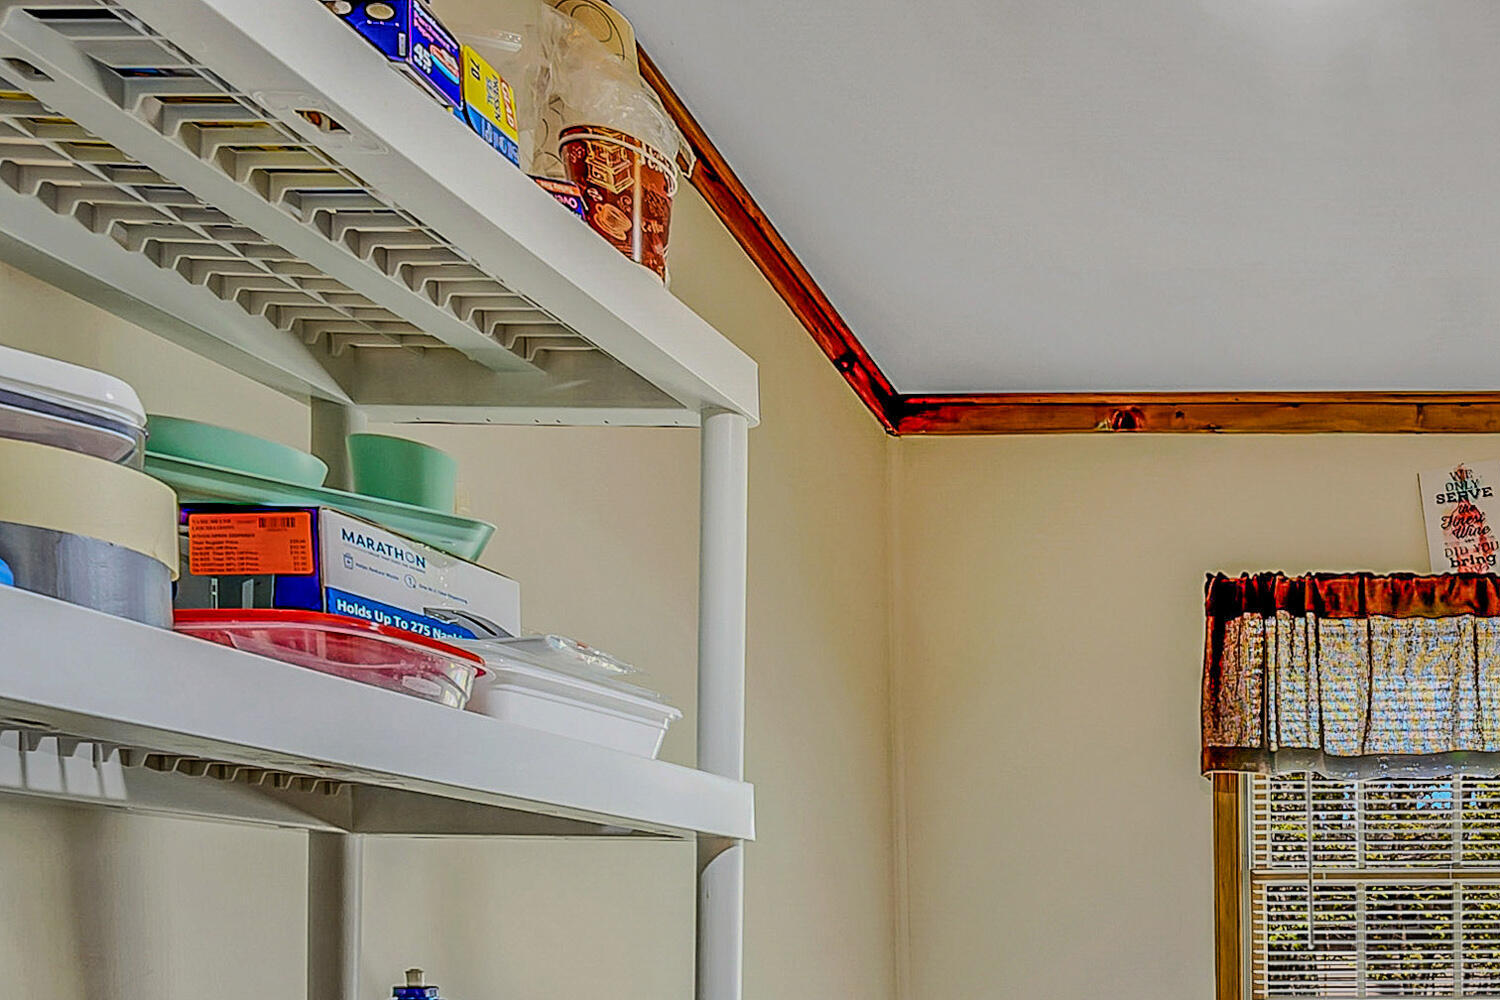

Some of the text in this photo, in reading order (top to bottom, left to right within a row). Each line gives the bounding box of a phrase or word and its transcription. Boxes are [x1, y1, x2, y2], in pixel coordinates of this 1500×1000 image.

[470, 57, 482, 82] 70
[1449, 469, 1474, 482] WE
[1444, 479, 1481, 492] ONLY
[1435, 486, 1494, 504] SERVE
[1457, 503, 1478, 514] the
[1451, 524, 1492, 539] Wine
[341, 528, 426, 569] MARATHON
[1474, 540, 1500, 555] YOU
[1449, 553, 1498, 568] bring
[337, 598, 372, 620] Holds
[373, 609, 392, 626] Up
[394, 615, 408, 630] To
[410, 620, 431, 636] 275
